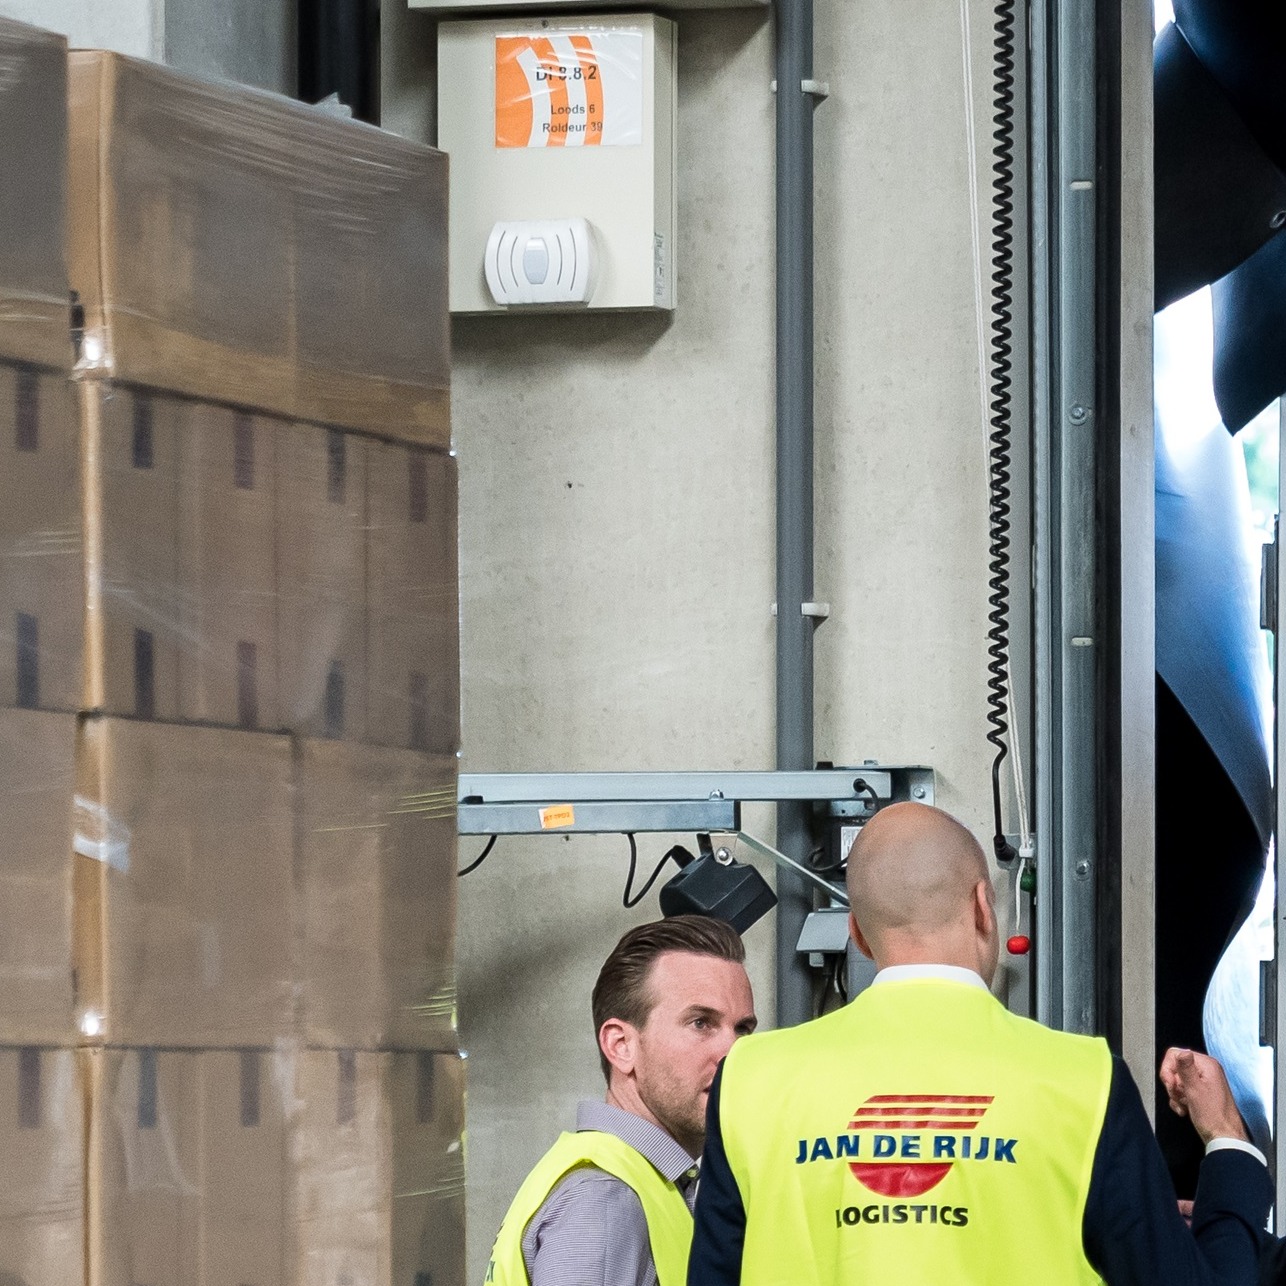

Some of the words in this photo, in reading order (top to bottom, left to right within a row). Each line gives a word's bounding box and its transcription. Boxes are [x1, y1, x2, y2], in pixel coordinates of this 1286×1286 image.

[550, 104, 586, 115] Loods
[589, 104, 596, 114] 6
[542, 122, 587, 133] Roldeur
[795, 1135, 860, 1164] JAN
[872, 1135, 921, 1158] DE
[933, 1135, 1018, 1164] RIJK
[836, 1205, 969, 1228] LOGISTICS
